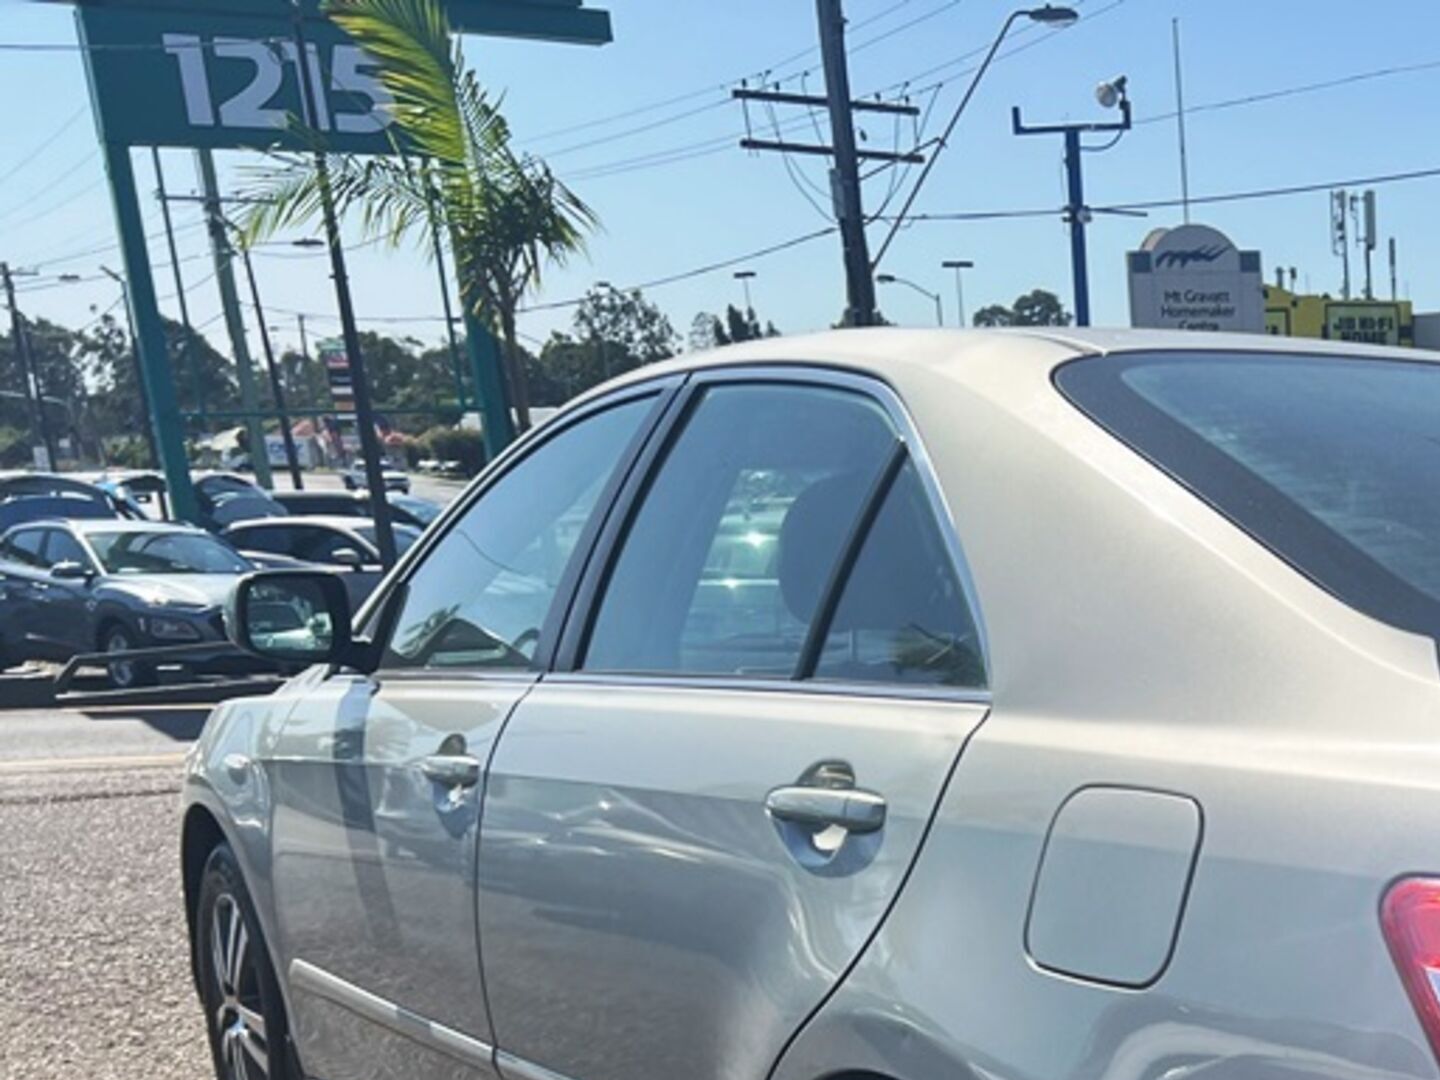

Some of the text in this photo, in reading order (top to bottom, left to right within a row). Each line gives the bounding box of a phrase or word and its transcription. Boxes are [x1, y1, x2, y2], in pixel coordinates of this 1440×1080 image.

[162, 33, 402, 133] 1215
[1163, 288, 1229, 304] Mt Gravatt
[1161, 304, 1235, 319] Homemaker
